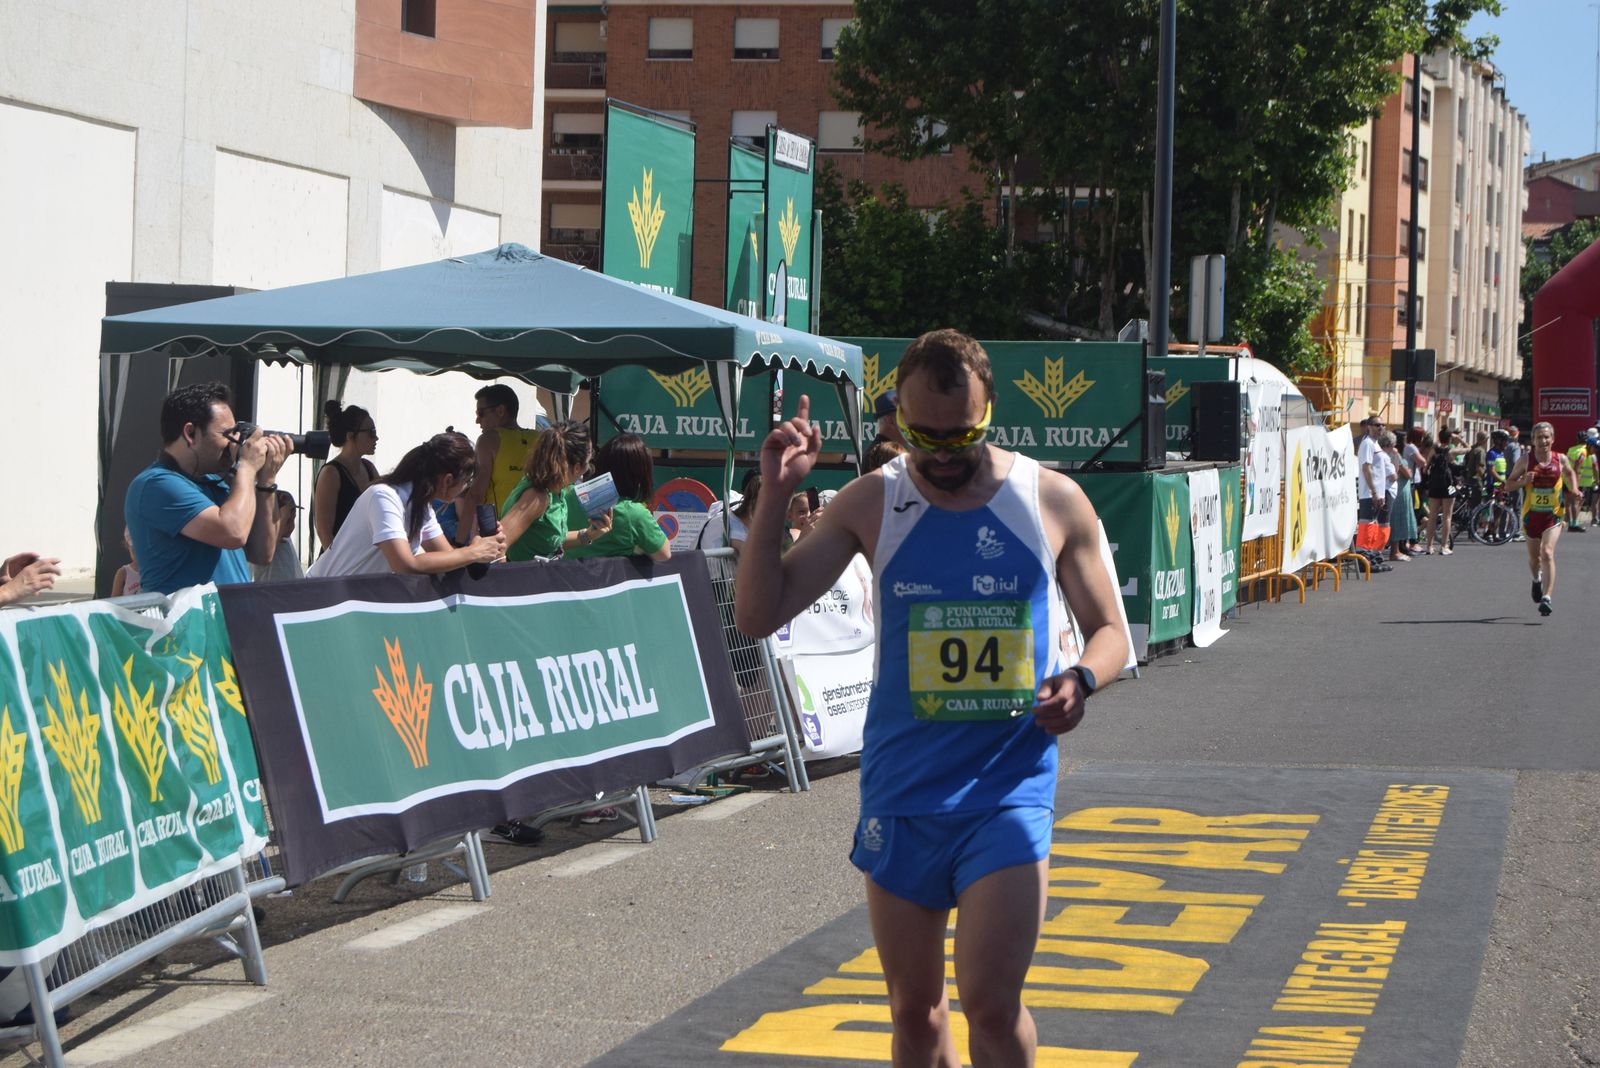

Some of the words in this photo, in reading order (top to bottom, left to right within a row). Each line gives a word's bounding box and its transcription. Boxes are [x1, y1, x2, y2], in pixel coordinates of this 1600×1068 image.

[1550, 403, 1588, 411] ZAMORA
[614, 413, 669, 435] CAJA
[809, 419, 851, 440] AJA
[1045, 426, 1128, 448] RURAL
[1536, 495, 1549, 505] 25
[946, 617, 974, 628] CAJA
[978, 617, 1017, 628] RURAL
[940, 636, 1004, 683] 94
[443, 659, 543, 751] CAJA
[536, 643, 660, 734] RURAL
[946, 698, 978, 711] CAJA
[982, 697, 1026, 711] RURAL
[827, 704, 848, 717] osea
[1363, 784, 1450, 846] INTERIORES
[1336, 849, 1431, 899] DISEÑO
[1272, 920, 1407, 1015] INTEGRAL
